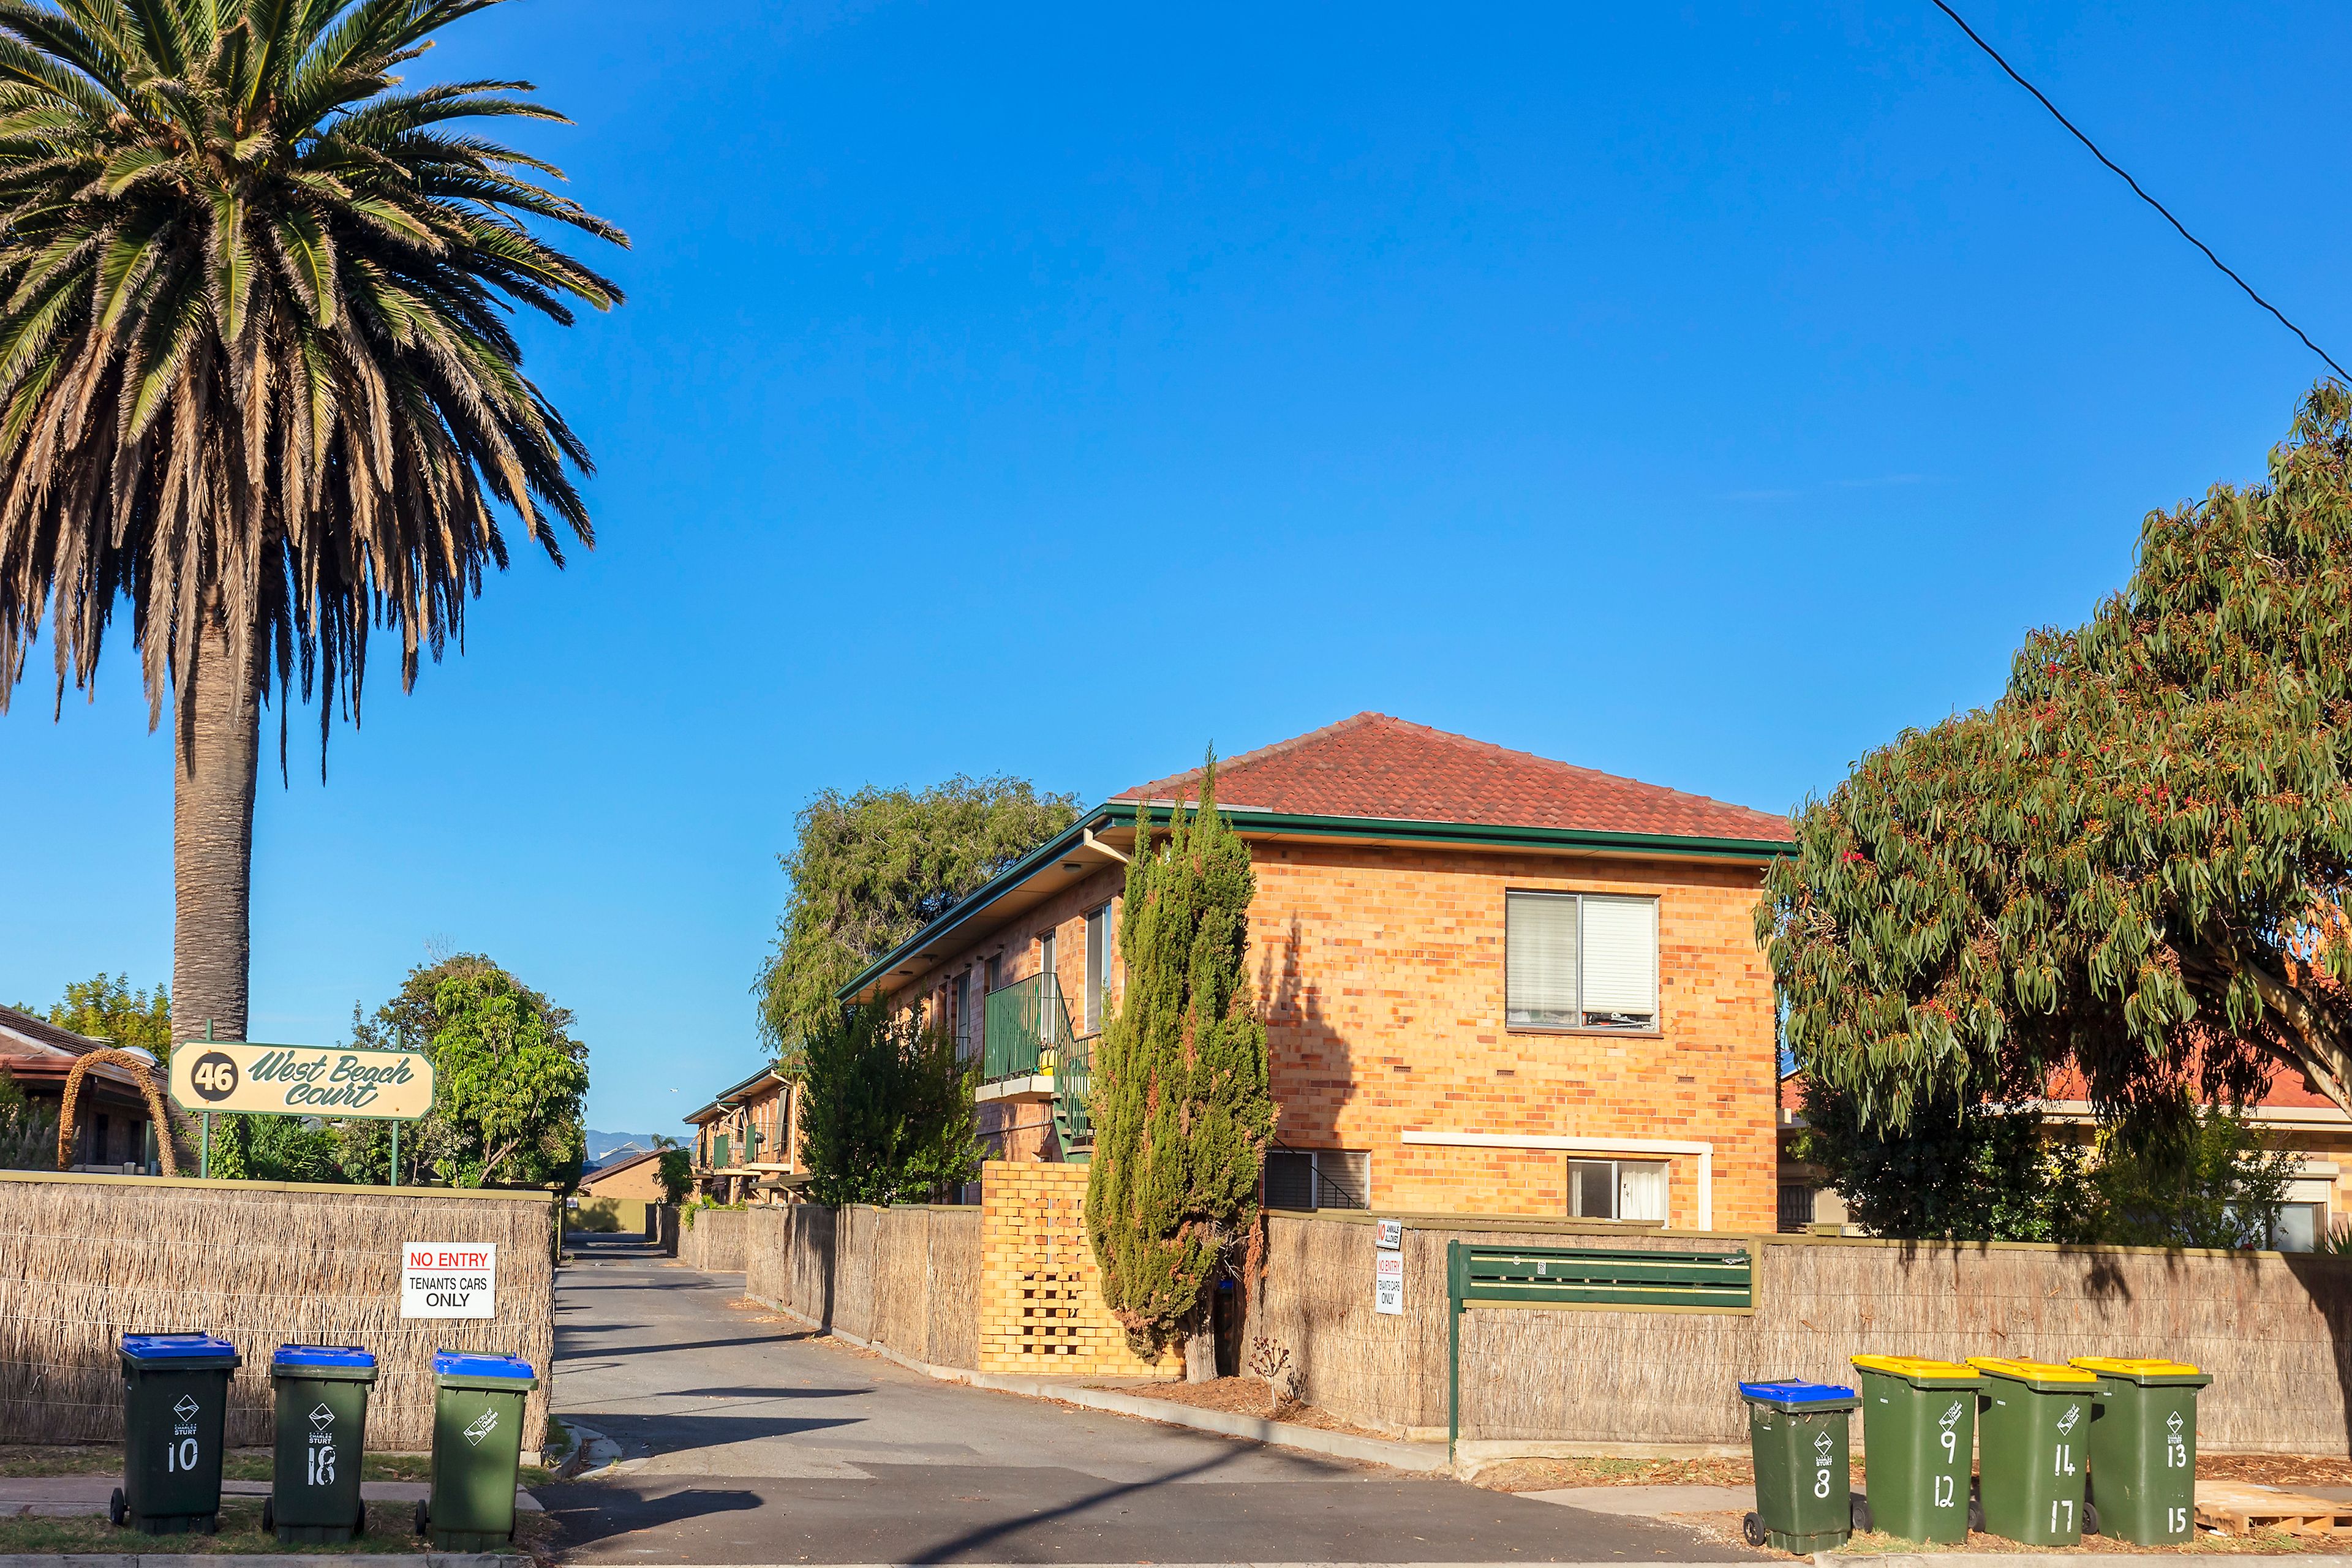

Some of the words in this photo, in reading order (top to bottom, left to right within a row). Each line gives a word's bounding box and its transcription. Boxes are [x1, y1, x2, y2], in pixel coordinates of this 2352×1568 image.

[194, 1063, 234, 1091] 46
[248, 1050, 327, 1082] West
[330, 1055, 415, 1085] Beach
[285, 1082, 379, 1109] Court
[1378, 1224, 1385, 1241] NO
[410, 1253, 433, 1266] NO
[439, 1253, 488, 1267] ENTRY
[1378, 1260, 1384, 1271] NO
[1385, 1260, 1401, 1272] ENTRY
[410, 1278, 456, 1290] TENANTS
[460, 1278, 487, 1290] CARS
[426, 1293, 470, 1306] ONLY
[1382, 1292, 1395, 1305] ONLY
[478, 1413, 488, 1423] City
[486, 1406, 492, 1415] of
[168, 1438, 198, 1472] 10
[1940, 1431, 1956, 1464] 9
[2055, 1444, 2076, 1477] 14
[2168, 1444, 2187, 1468] 13
[308, 1446, 336, 1485] 18
[1814, 1469, 1830, 1498] 8
[1935, 1476, 1954, 1507] 12
[2051, 1500, 2073, 1533] 17
[2168, 1507, 2186, 1533] 15
